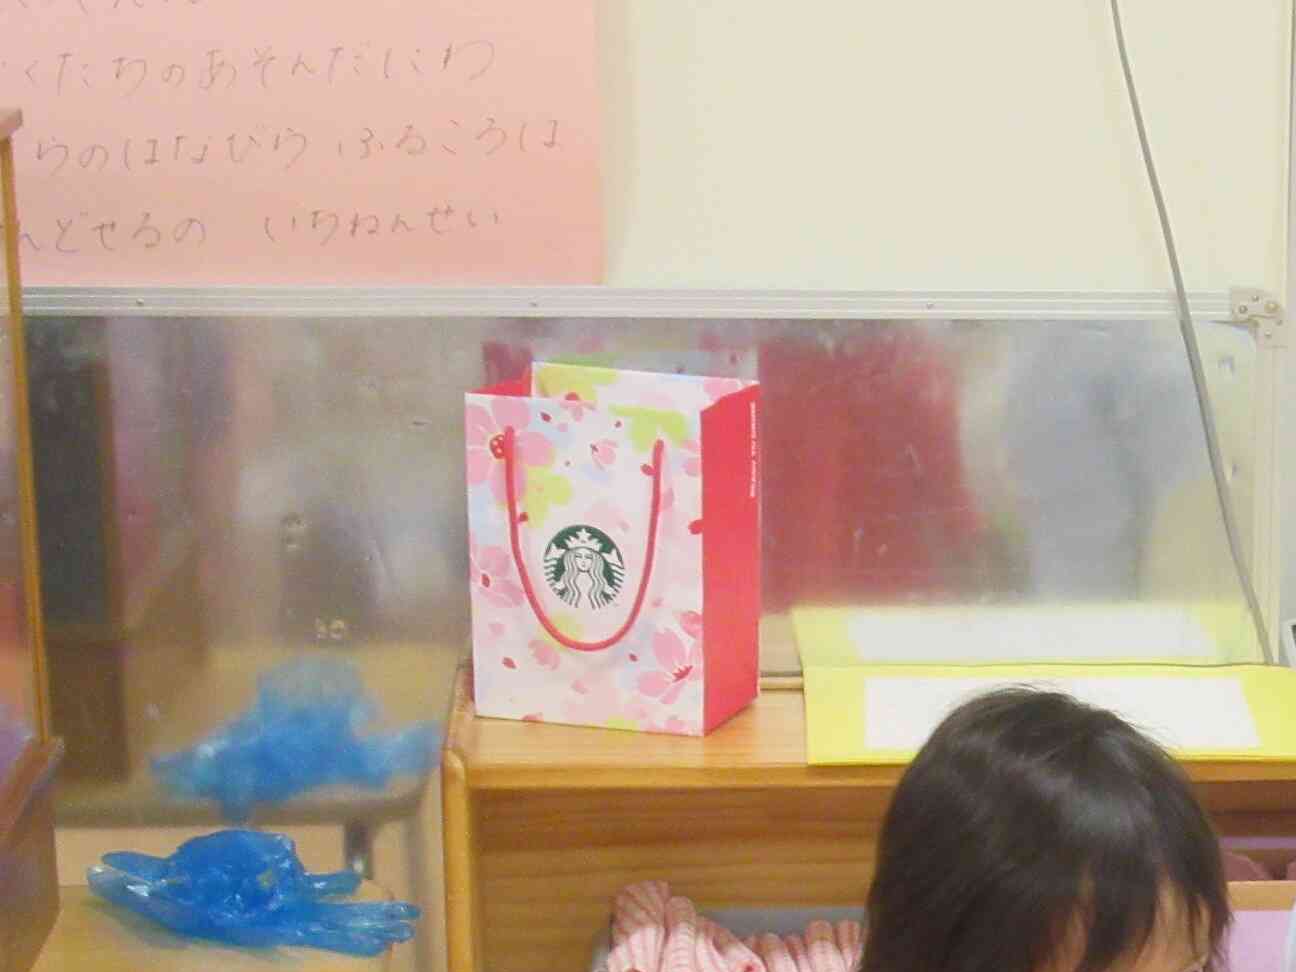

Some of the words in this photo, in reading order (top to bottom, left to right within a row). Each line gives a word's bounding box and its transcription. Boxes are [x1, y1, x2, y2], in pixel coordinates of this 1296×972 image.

[1, 41, 495, 98] くたちのあそんだにわ
